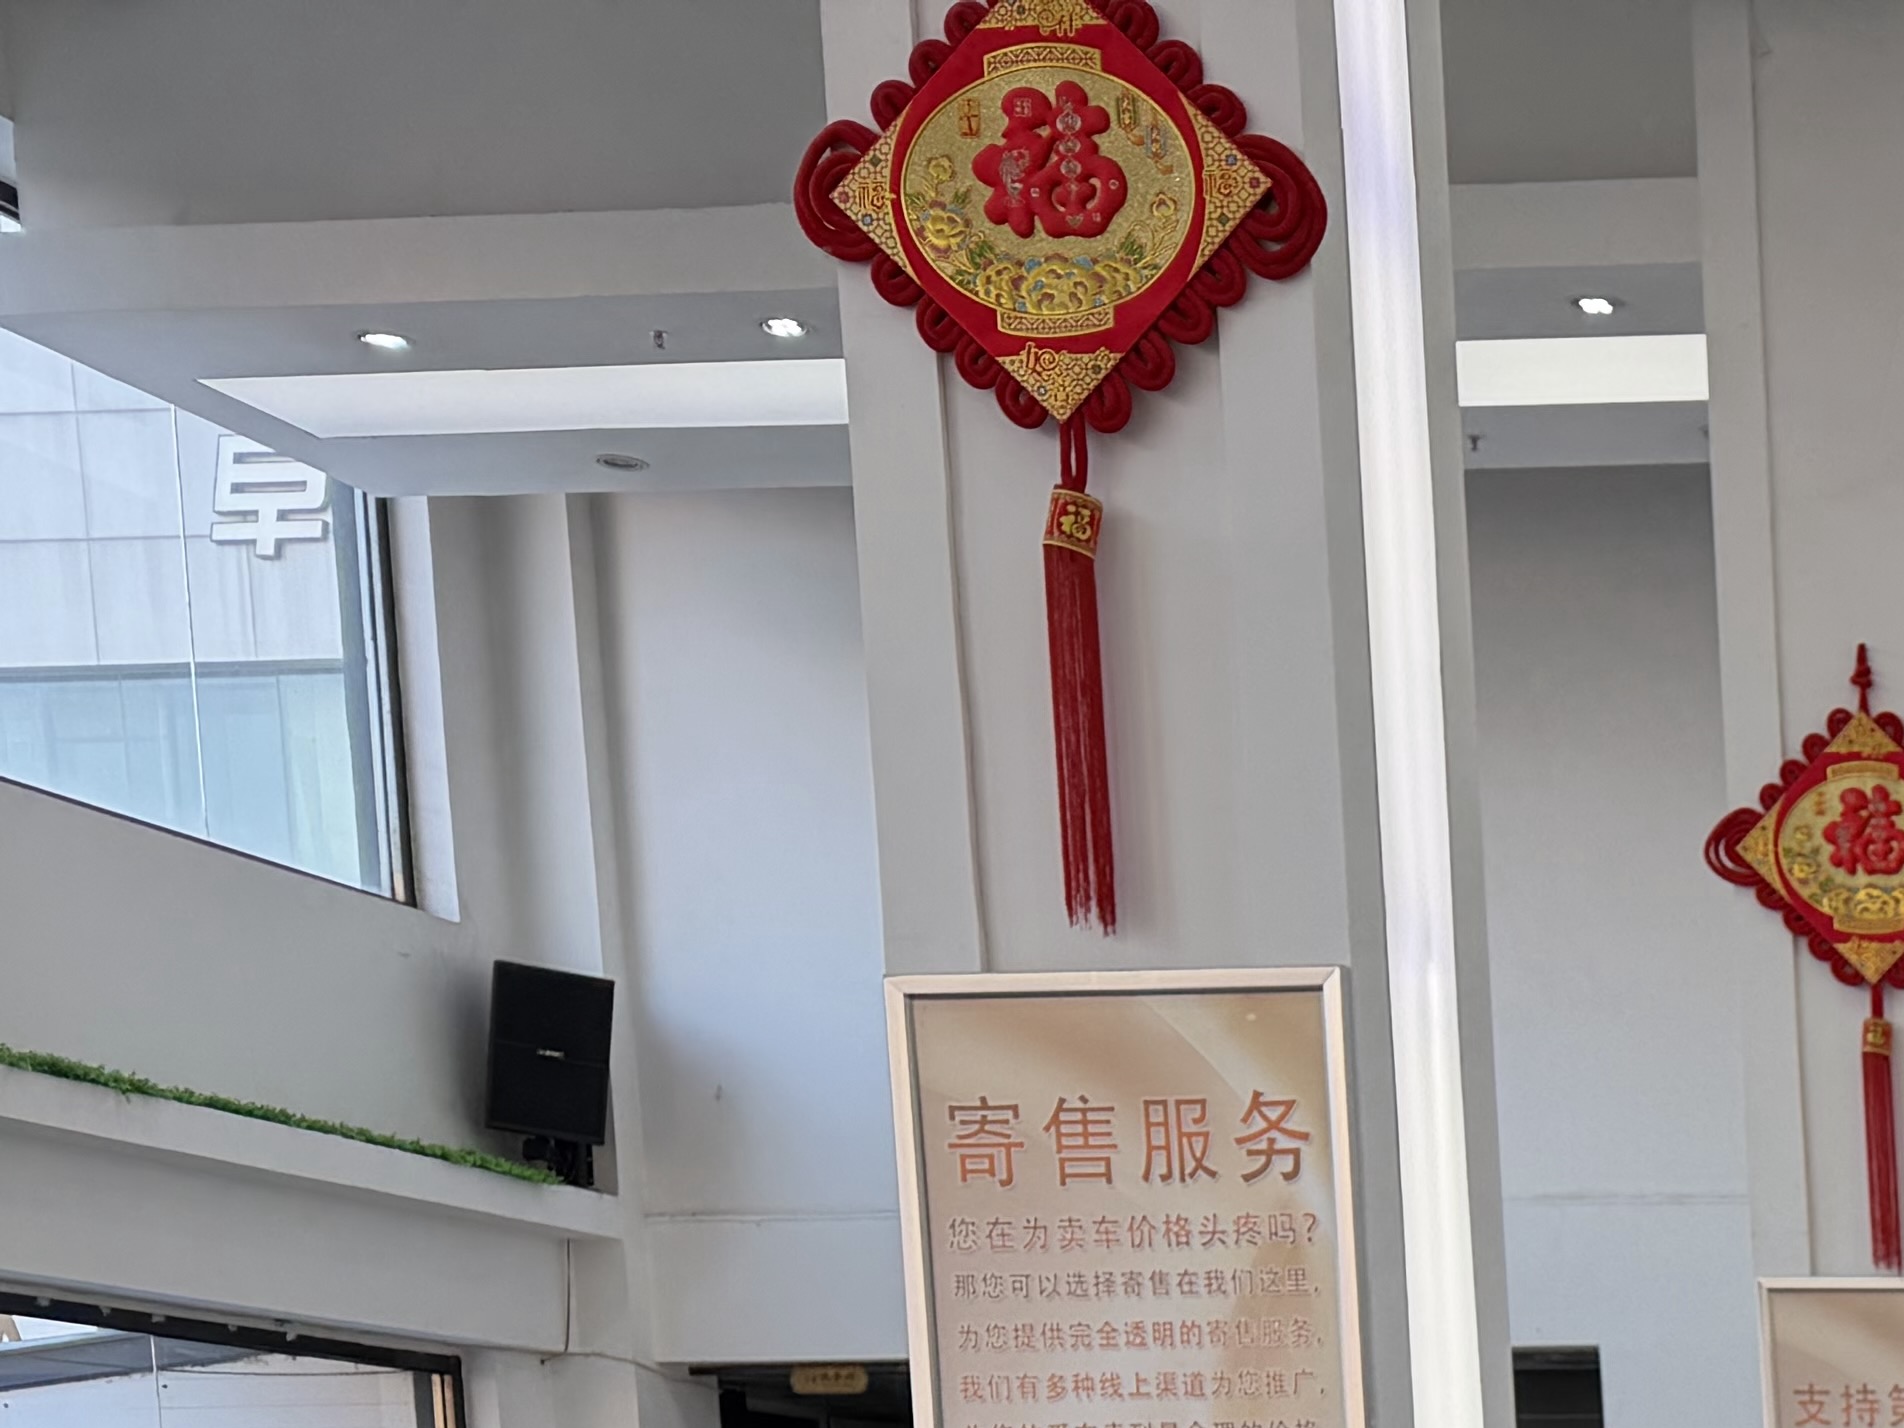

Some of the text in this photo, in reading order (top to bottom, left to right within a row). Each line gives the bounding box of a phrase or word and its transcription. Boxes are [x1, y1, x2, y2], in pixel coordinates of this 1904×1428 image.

[972, 81, 1128, 238] 福
[947, 1089, 1311, 1187] 寄售服务
